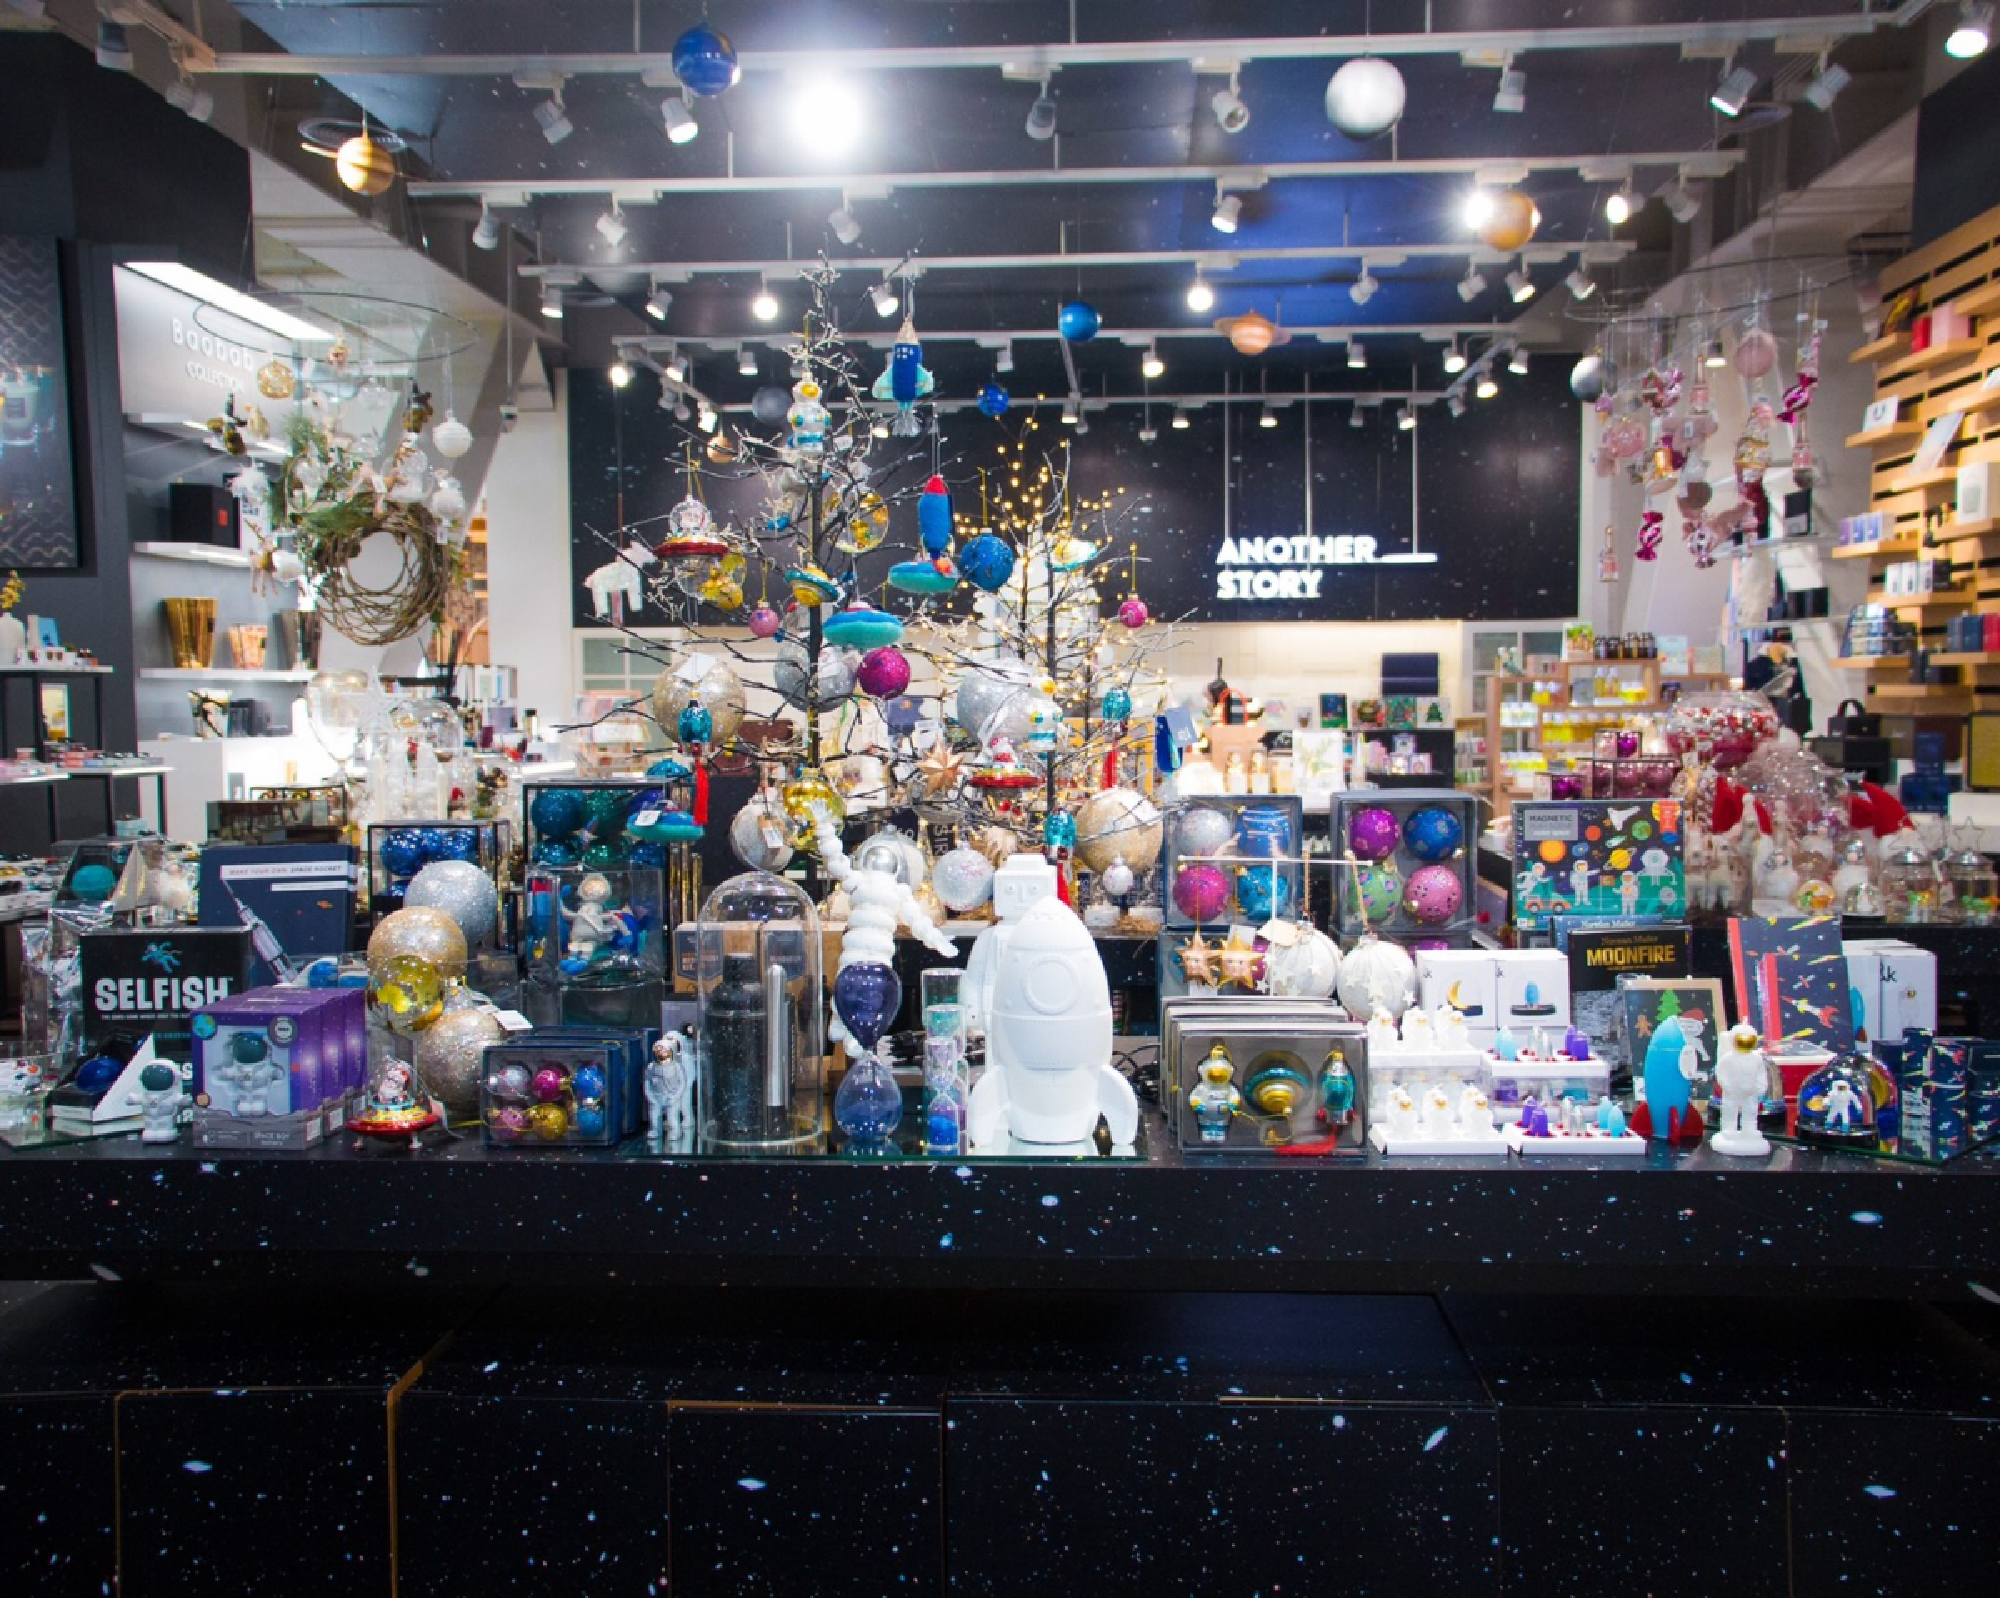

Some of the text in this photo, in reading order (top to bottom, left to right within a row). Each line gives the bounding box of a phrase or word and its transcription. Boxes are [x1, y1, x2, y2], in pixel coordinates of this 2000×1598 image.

[172, 317, 253, 372] Baobab
[185, 361, 245, 393] COLLECTION
[1216, 535, 1378, 564] ANOTHER
[1216, 569, 1323, 598] STORY
[1529, 814, 1573, 822] MAGNETIC
[1586, 945, 1676, 967] MOONFIRE
[95, 976, 229, 1011] SELFISH
